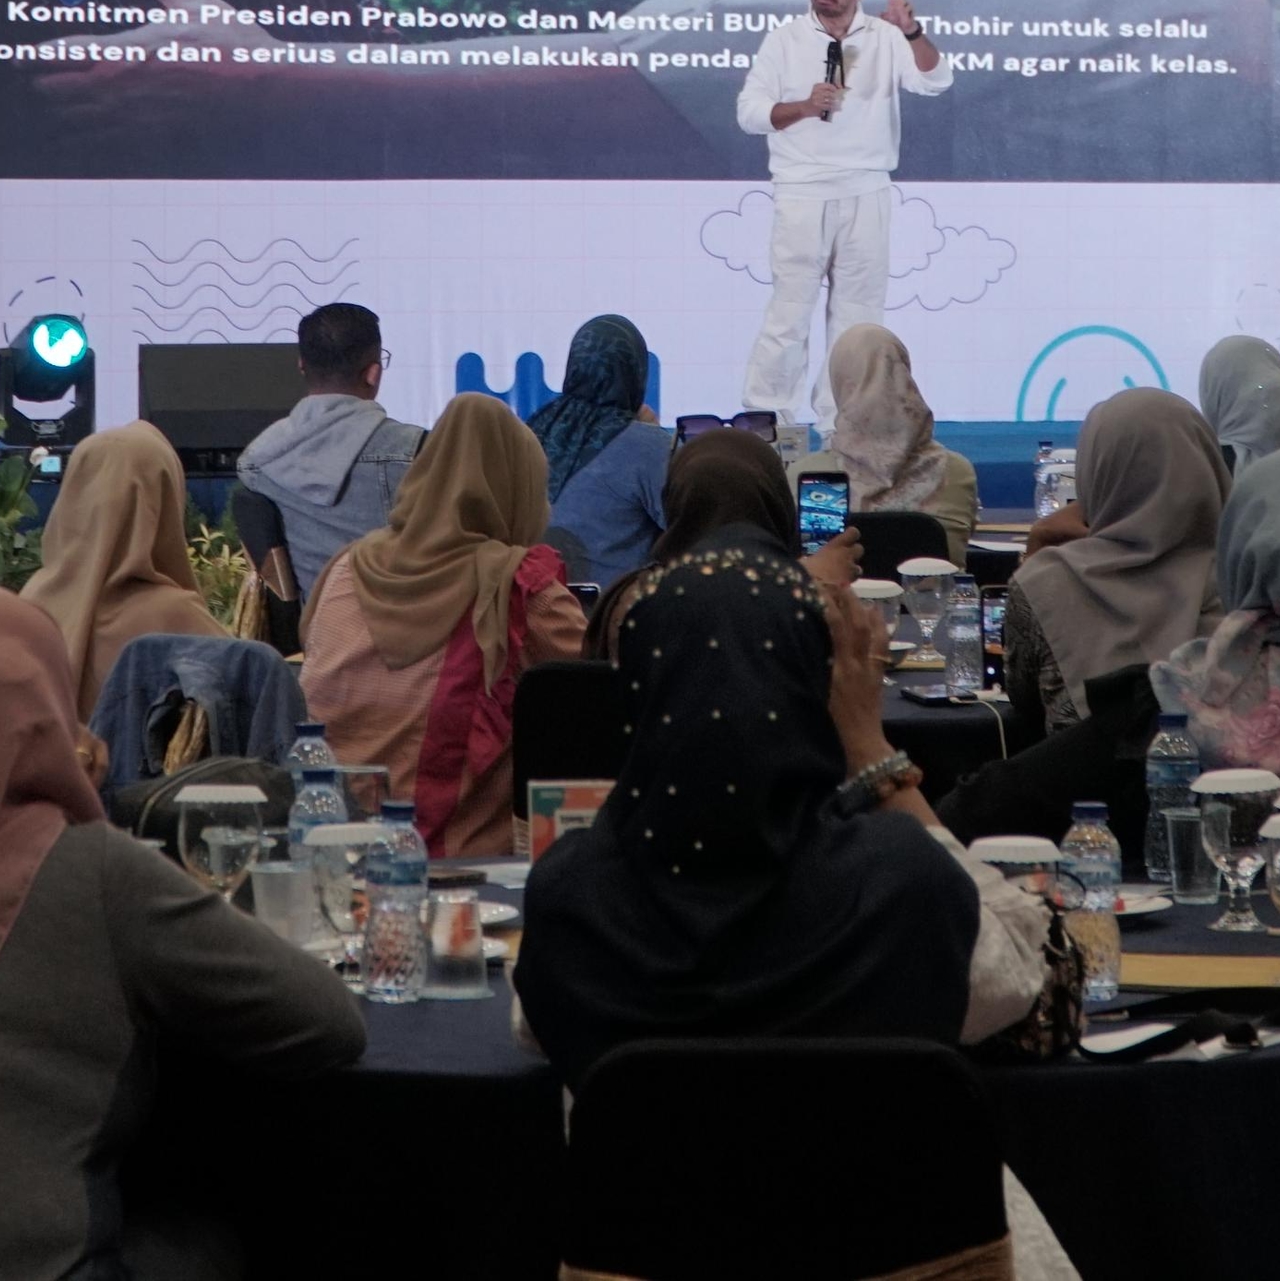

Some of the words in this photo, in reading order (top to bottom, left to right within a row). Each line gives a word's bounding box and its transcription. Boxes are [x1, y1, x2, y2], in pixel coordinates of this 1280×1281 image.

[7, 1, 189, 24] Komitmen
[200, 4, 351, 27] Presiden
[361, 7, 507, 28] Prabowo
[517, 9, 578, 30] dan
[587, 11, 714, 32] Menteri
[723, 13, 804, 33] BUM
[913, 15, 1014, 36] Thohir
[1022, 18, 1110, 38] untuk
[1119, 18, 1208, 39] selalu
[156, 41, 222, 63] dan
[231, 43, 337, 64] serius
[346, 43, 450, 65] dalam
[460, 45, 640, 67] melakukan
[939, 51, 994, 72] KM
[1002, 56, 1070, 78] agar
[1078, 53, 1142, 73] naik
[1150, 54, 1238, 75] kelas.
